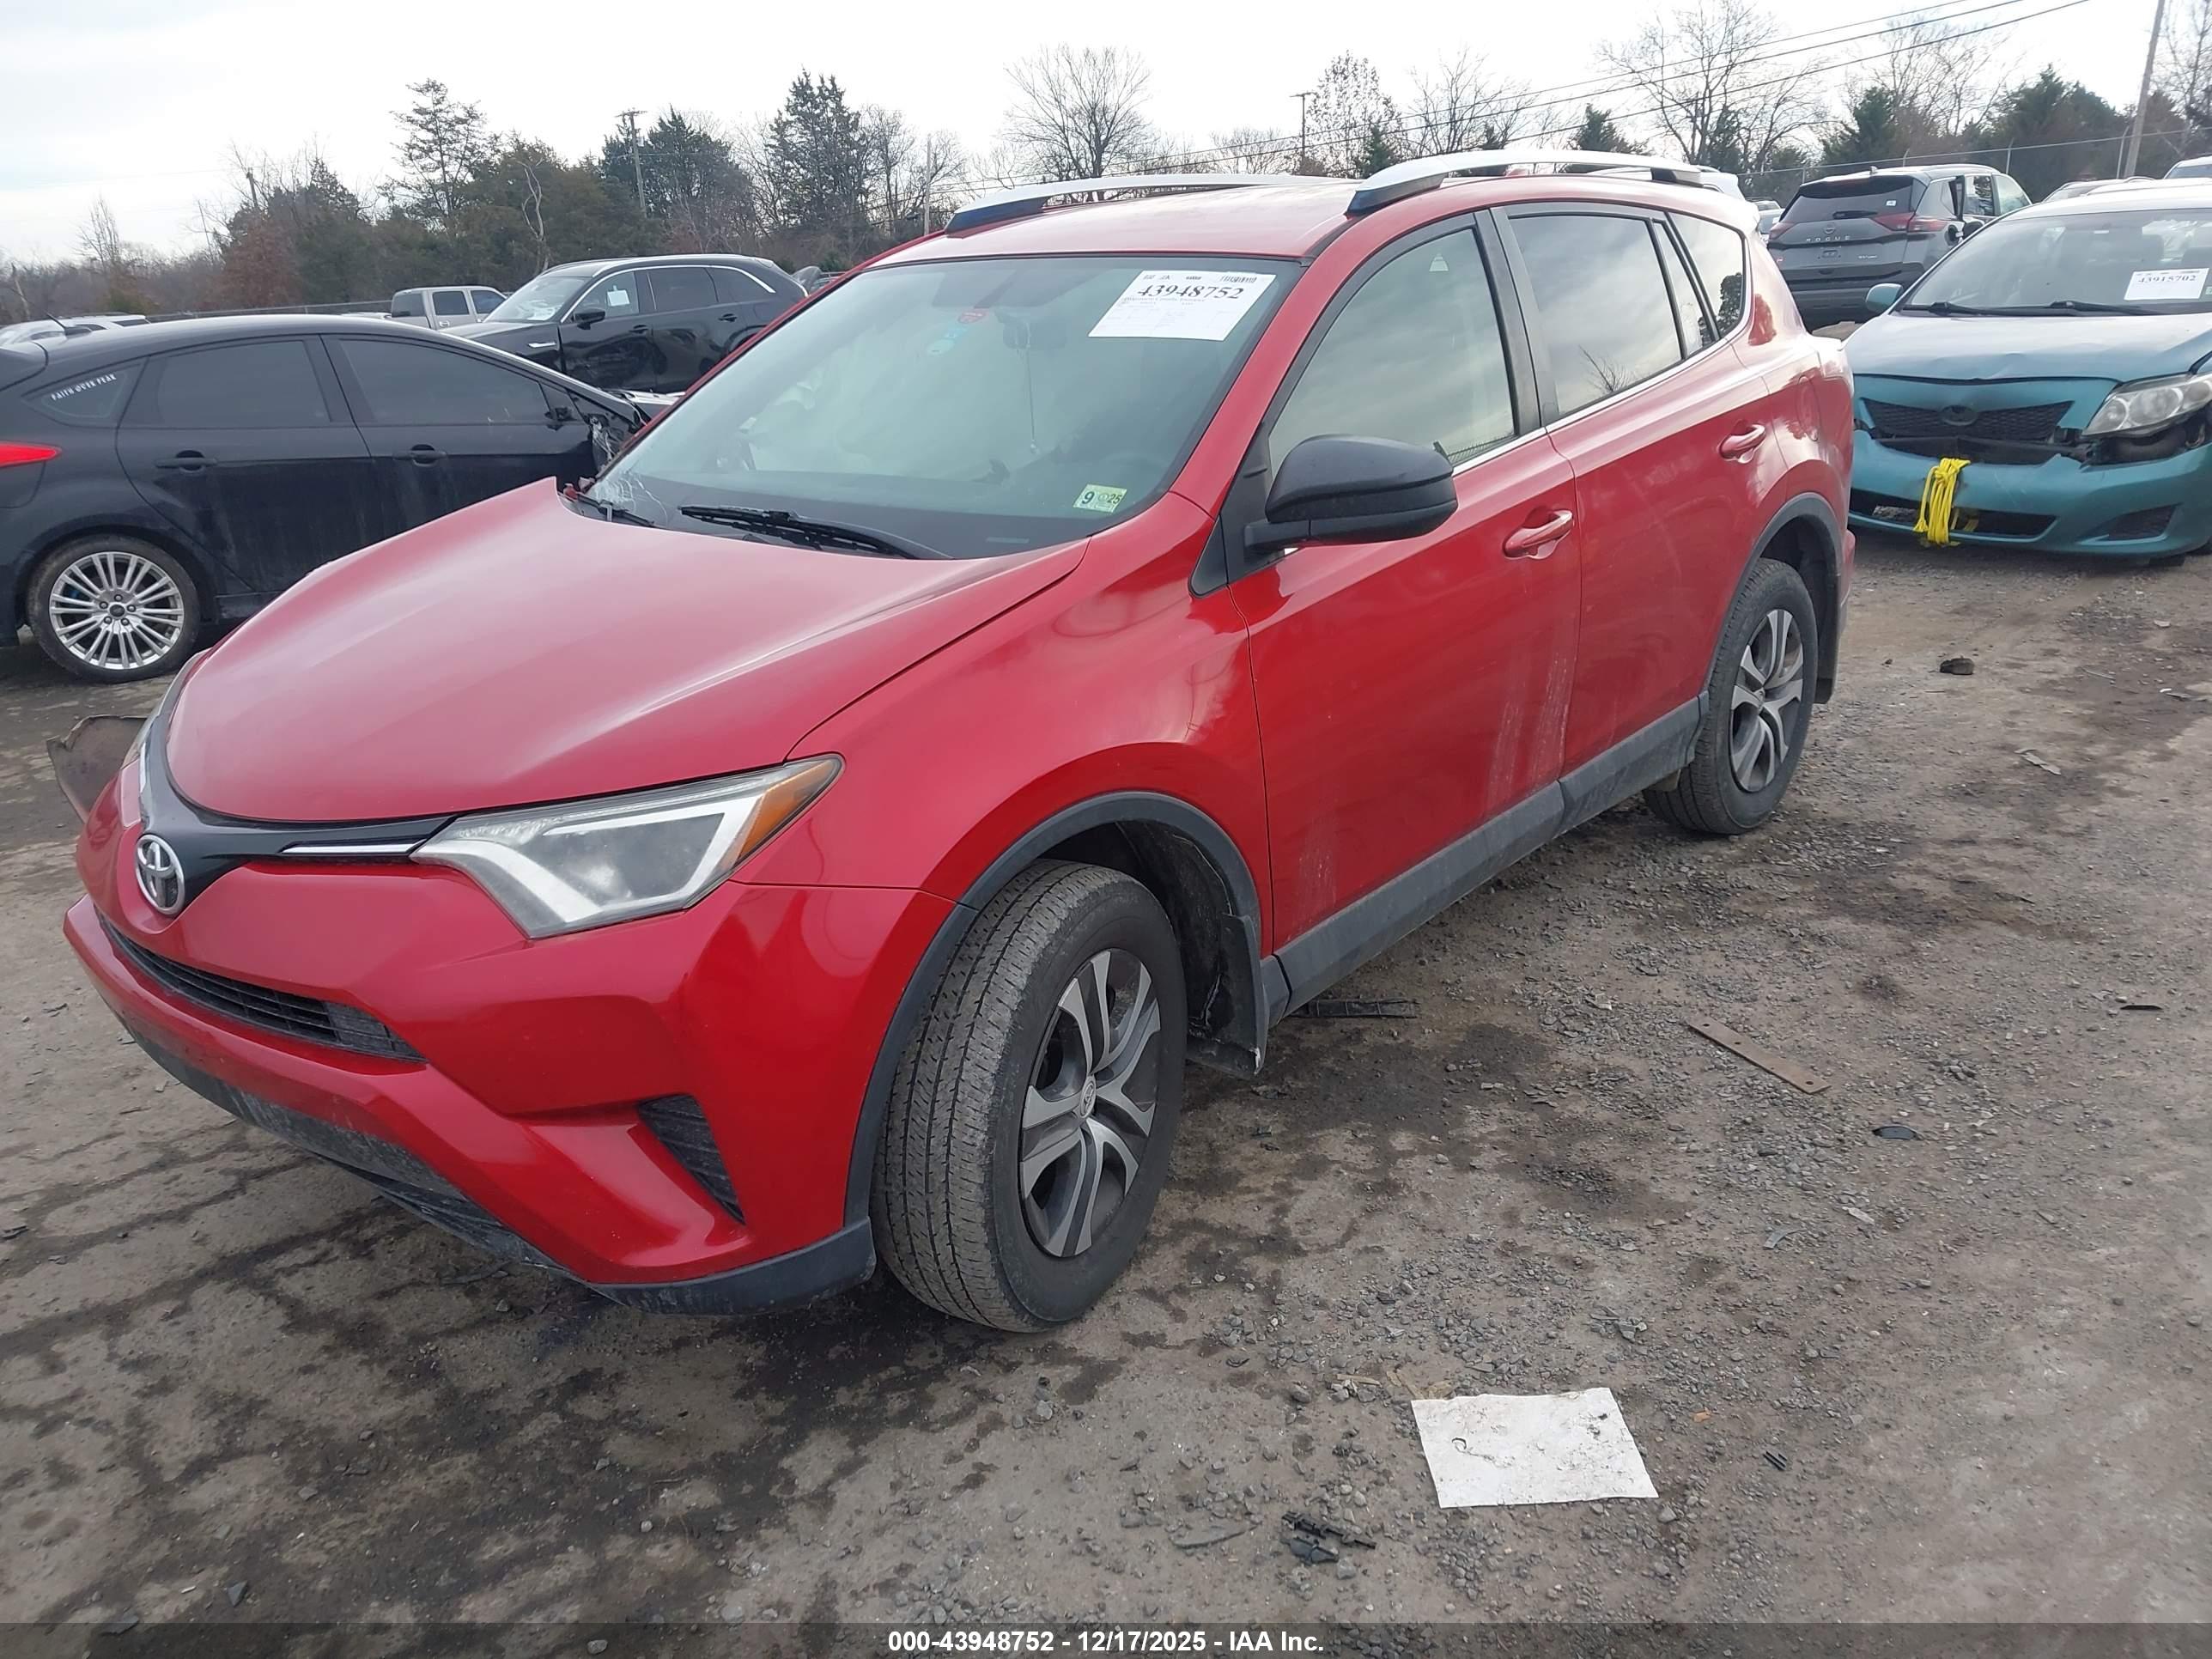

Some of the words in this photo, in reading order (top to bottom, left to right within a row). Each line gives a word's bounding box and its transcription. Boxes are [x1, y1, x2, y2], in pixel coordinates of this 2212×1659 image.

[1137, 284, 1244, 300] 43948752
[1082, 490, 1095, 504] 9
[1107, 494, 1122, 504] 25
